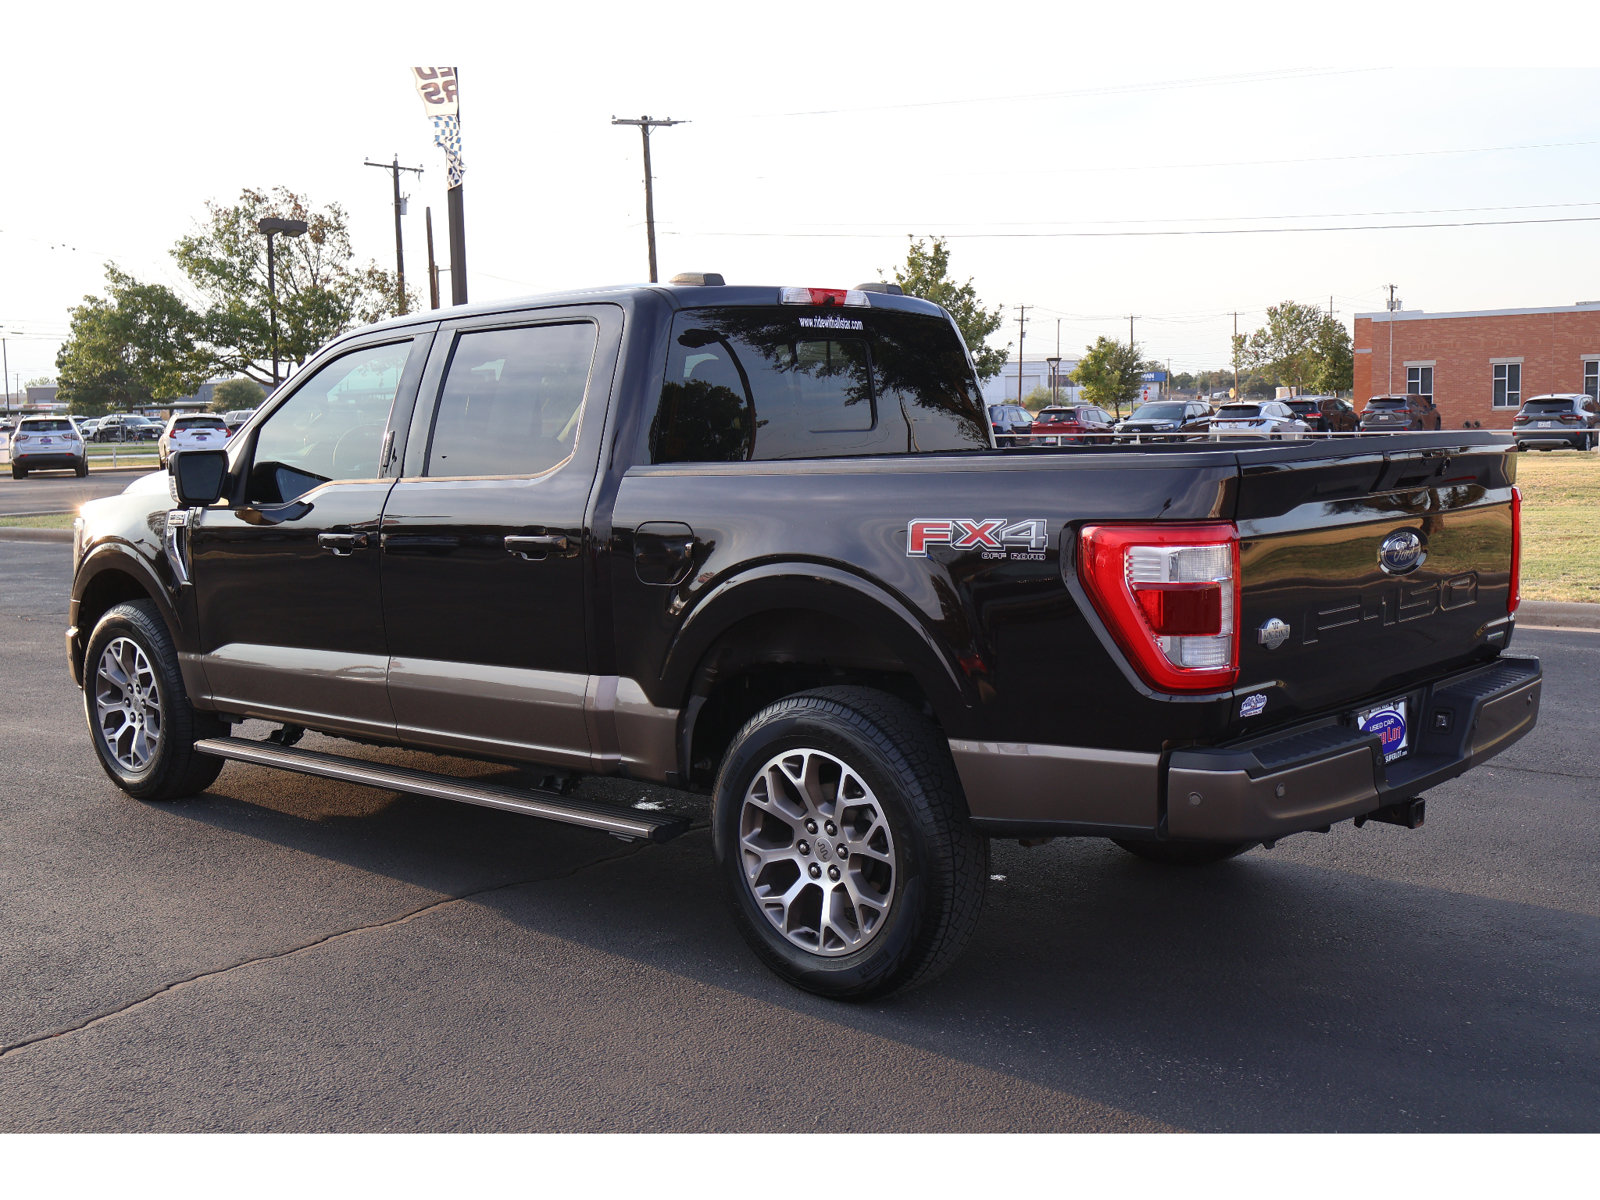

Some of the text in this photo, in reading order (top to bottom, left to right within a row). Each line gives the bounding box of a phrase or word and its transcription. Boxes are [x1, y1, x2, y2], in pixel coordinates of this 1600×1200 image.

[906, 518, 1049, 557] FX4
[981, 552, 1047, 560] OFF ROAD
[1369, 718, 1395, 732] USED CAR
